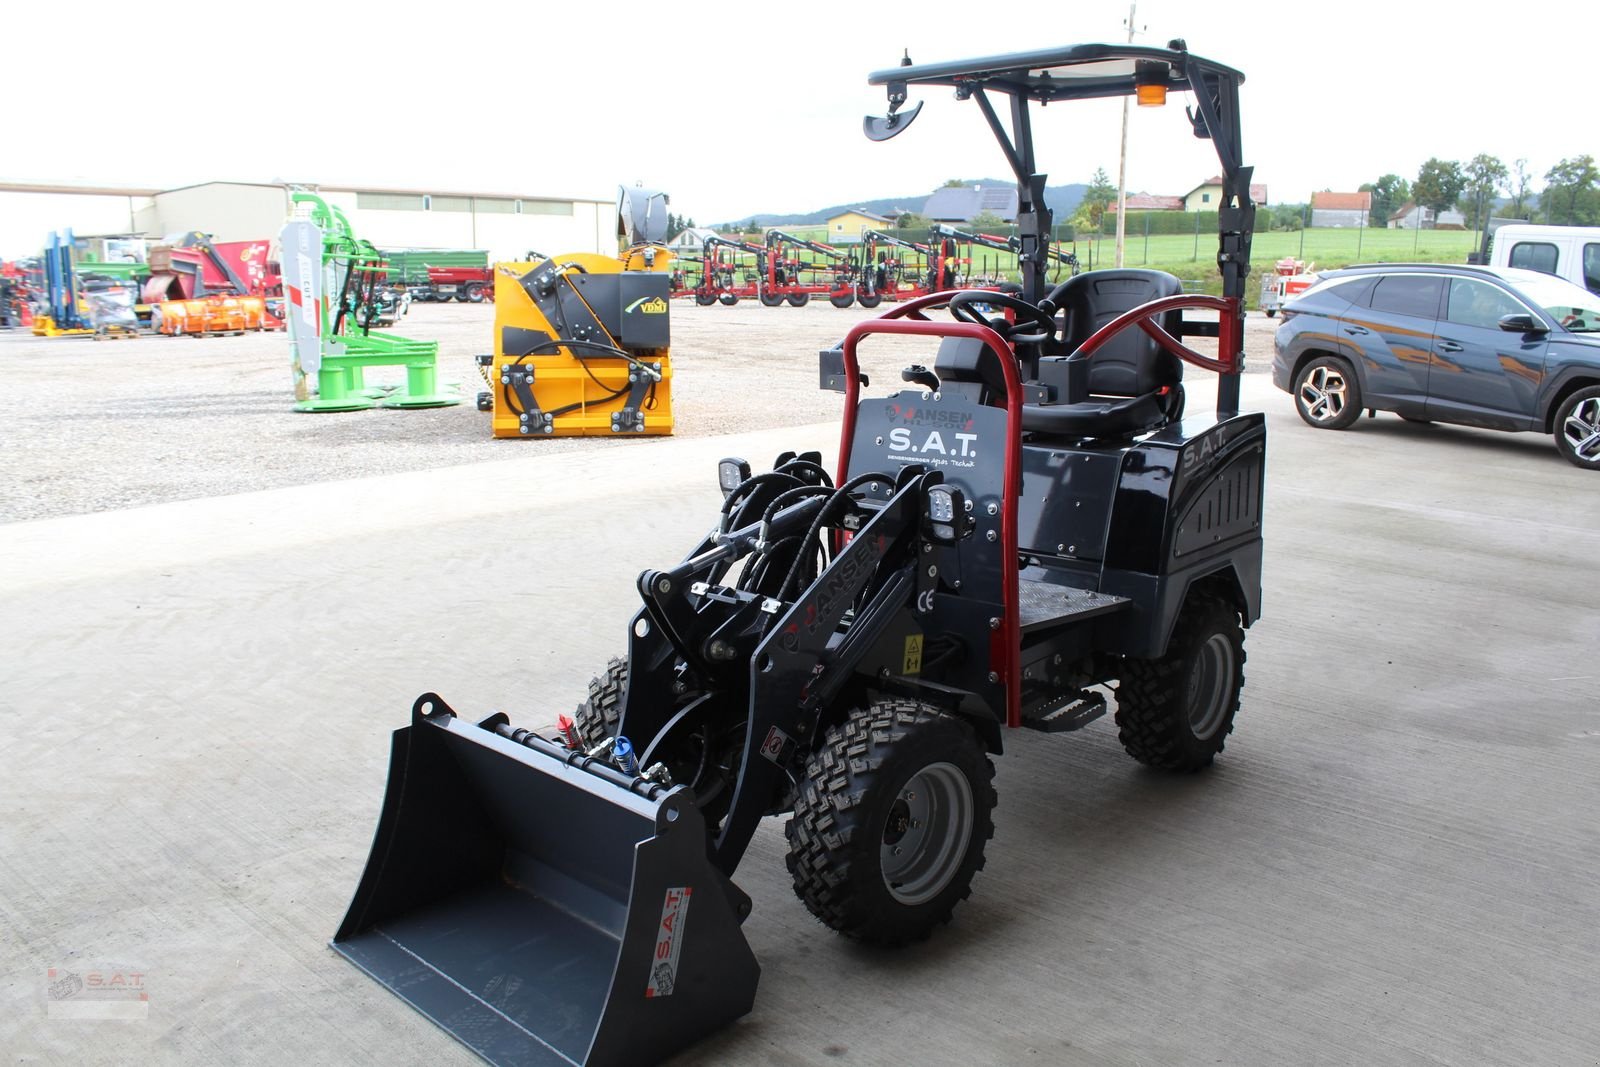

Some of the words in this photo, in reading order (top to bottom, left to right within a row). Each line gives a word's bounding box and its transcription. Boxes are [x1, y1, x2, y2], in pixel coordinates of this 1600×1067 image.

[903, 406, 973, 424] JANSEN
[888, 427, 978, 458] S.A.T.
[1183, 425, 1227, 469] S.A.T.
[657, 890, 682, 960] S.A.T.
